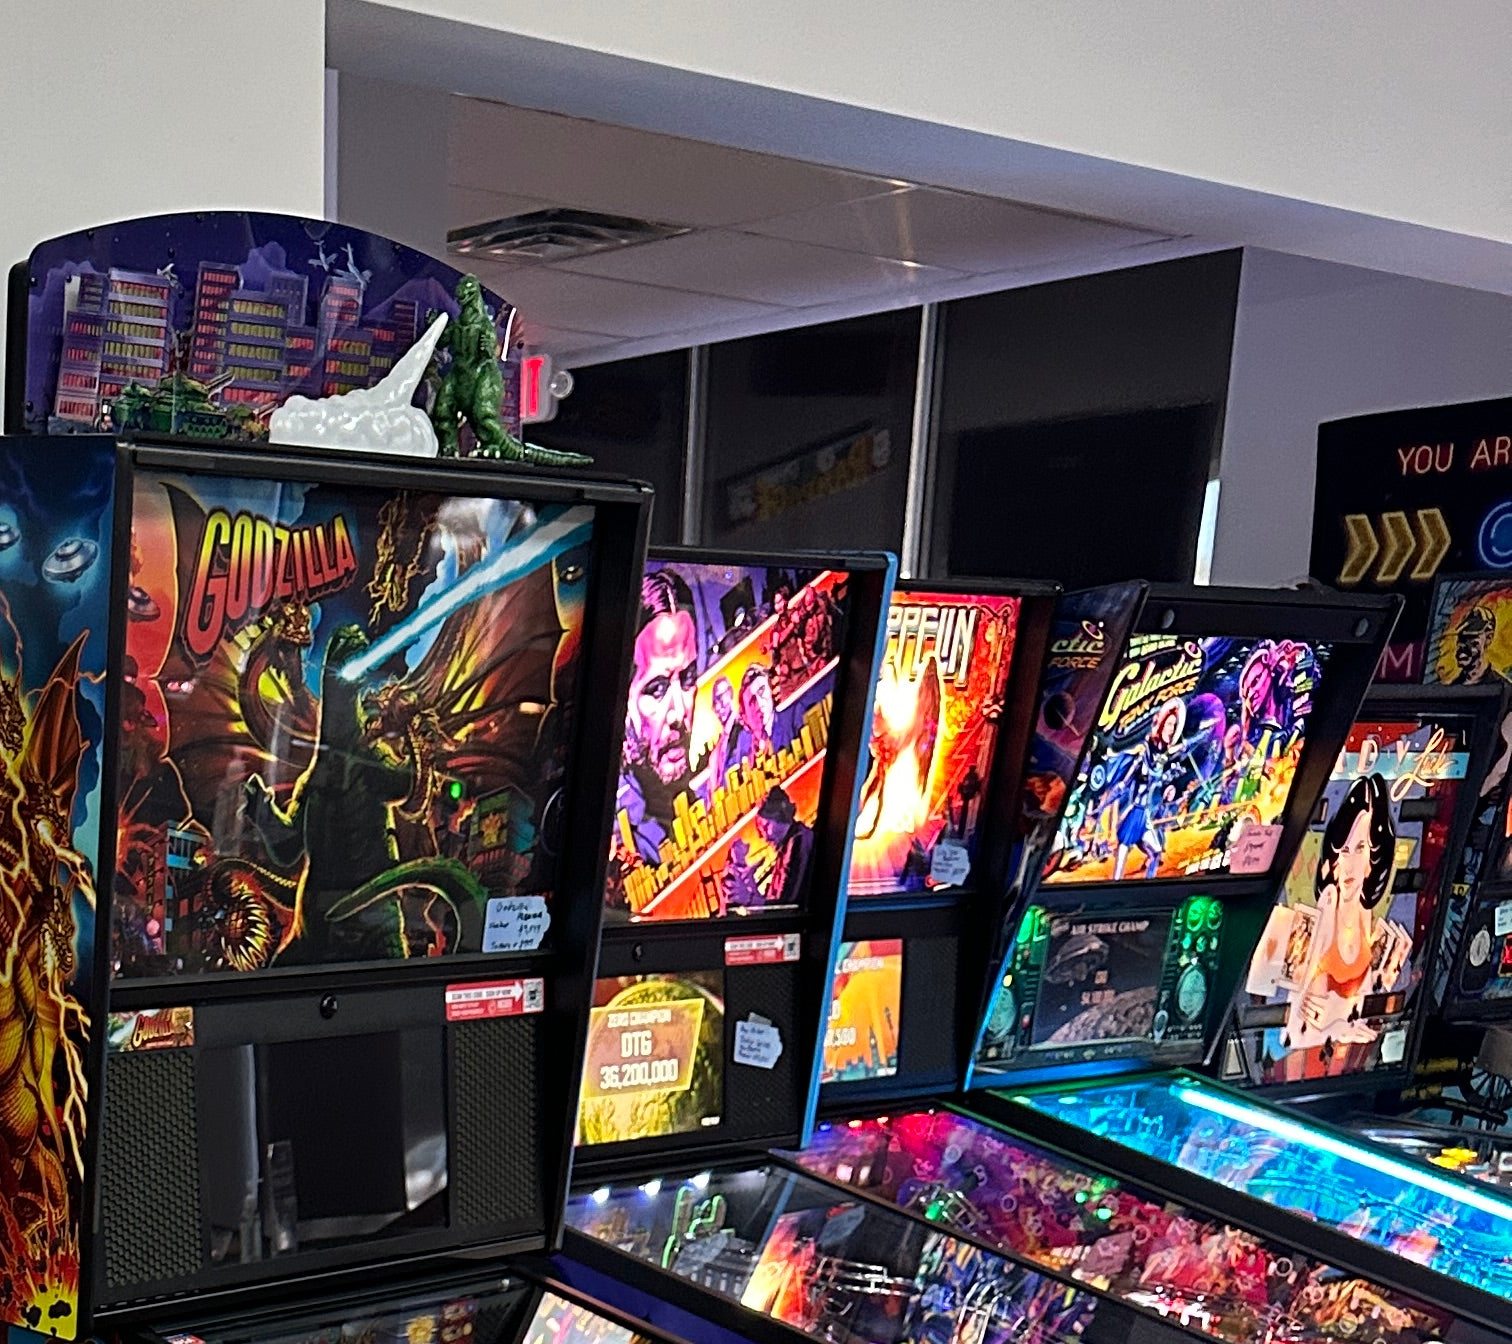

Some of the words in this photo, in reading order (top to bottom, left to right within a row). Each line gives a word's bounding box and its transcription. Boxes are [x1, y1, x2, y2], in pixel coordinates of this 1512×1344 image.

[1397, 442, 1455, 477] YOU
[1470, 436, 1512, 470] AR
[186, 511, 357, 655] GODZILLA
[888, 605, 978, 685] PPELIN
[1051, 632, 1105, 654] ctic
[1097, 652, 1203, 728] Galactic
[620, 1030, 653, 1058] DTG
